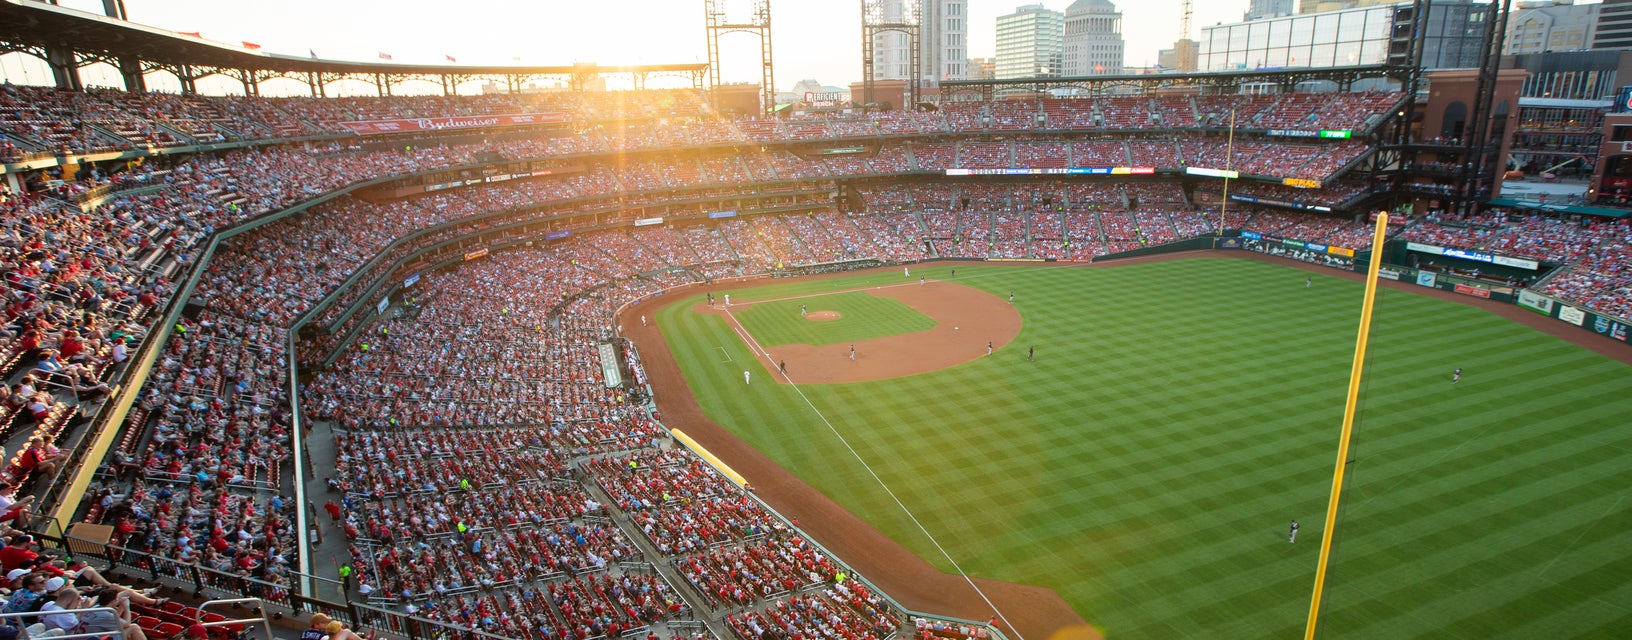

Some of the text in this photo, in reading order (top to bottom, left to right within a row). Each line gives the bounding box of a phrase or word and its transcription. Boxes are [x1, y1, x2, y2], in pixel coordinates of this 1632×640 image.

[805, 92, 842, 103] PERFICIENT
[409, 117, 498, 129] Budweiser
[306, 631, 321, 639] SMITH
